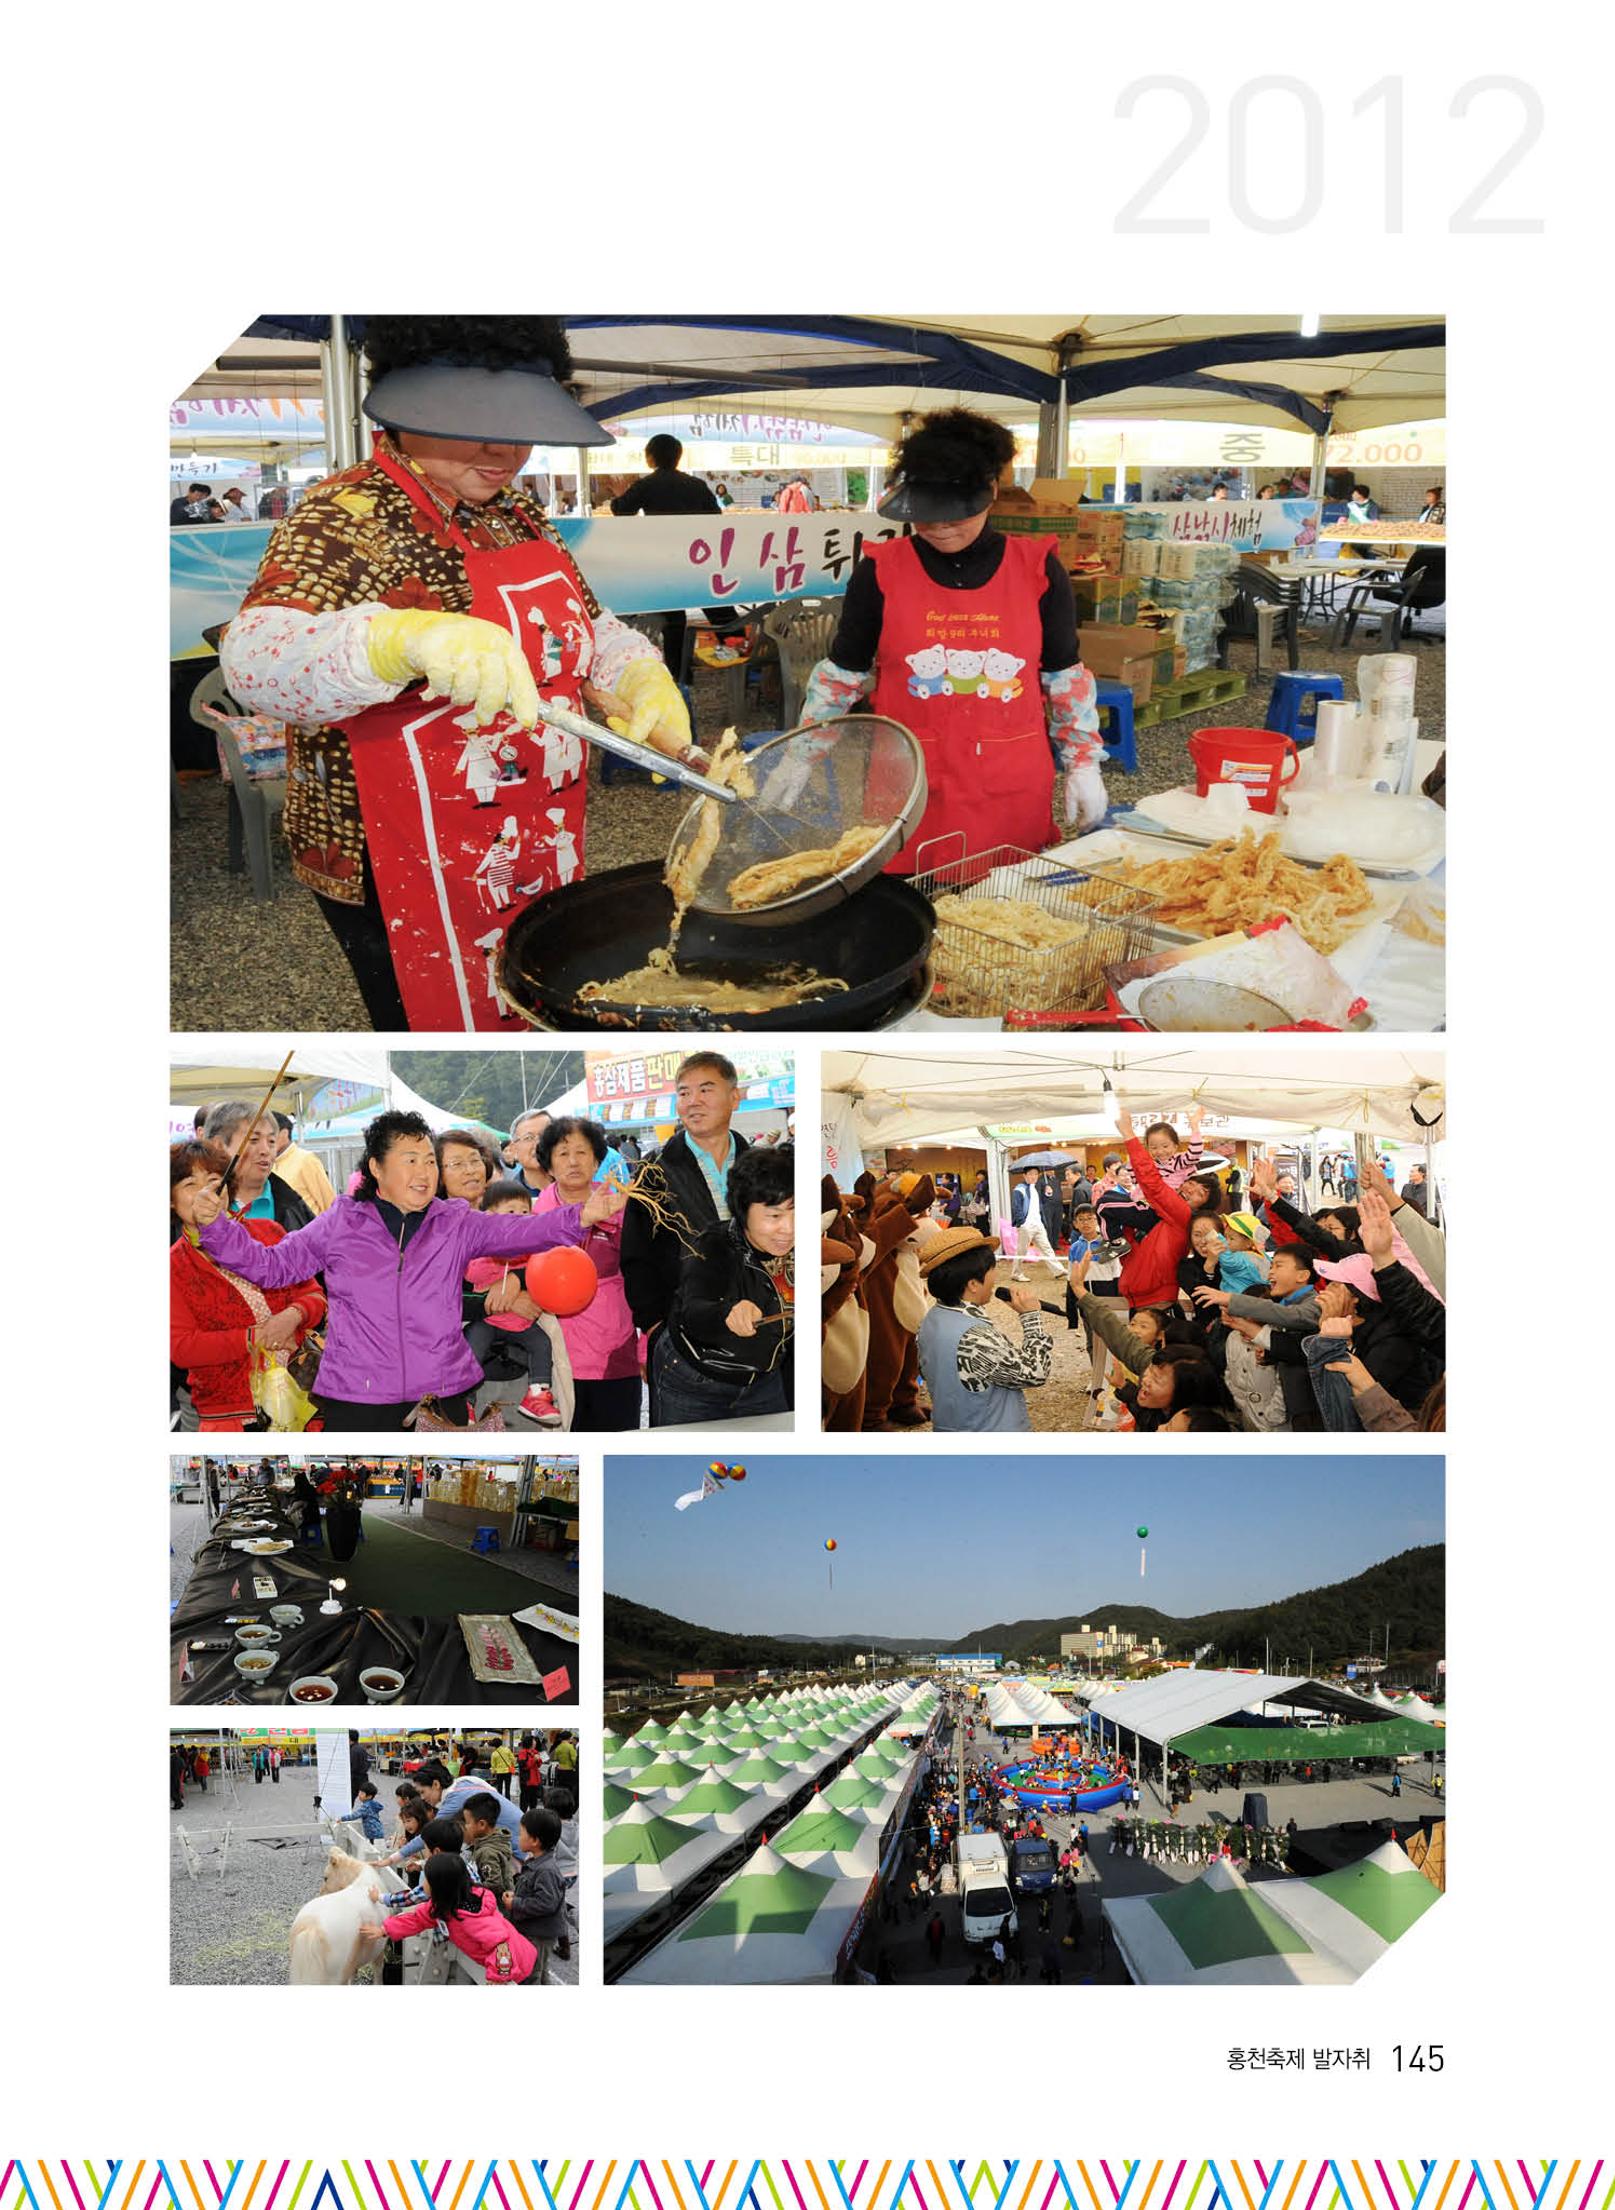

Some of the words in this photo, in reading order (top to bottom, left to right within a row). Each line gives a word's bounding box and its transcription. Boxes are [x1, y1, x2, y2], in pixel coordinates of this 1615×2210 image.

[1113, 74, 1545, 235] 2012
[730, 446, 780, 466] 특대
[1219, 433, 1266, 463] 중
[1226, 2047, 1305, 2071] 홍천축제
[1313, 2047, 1371, 2071] 발자취
[1392, 2044, 1445, 2072] 145
